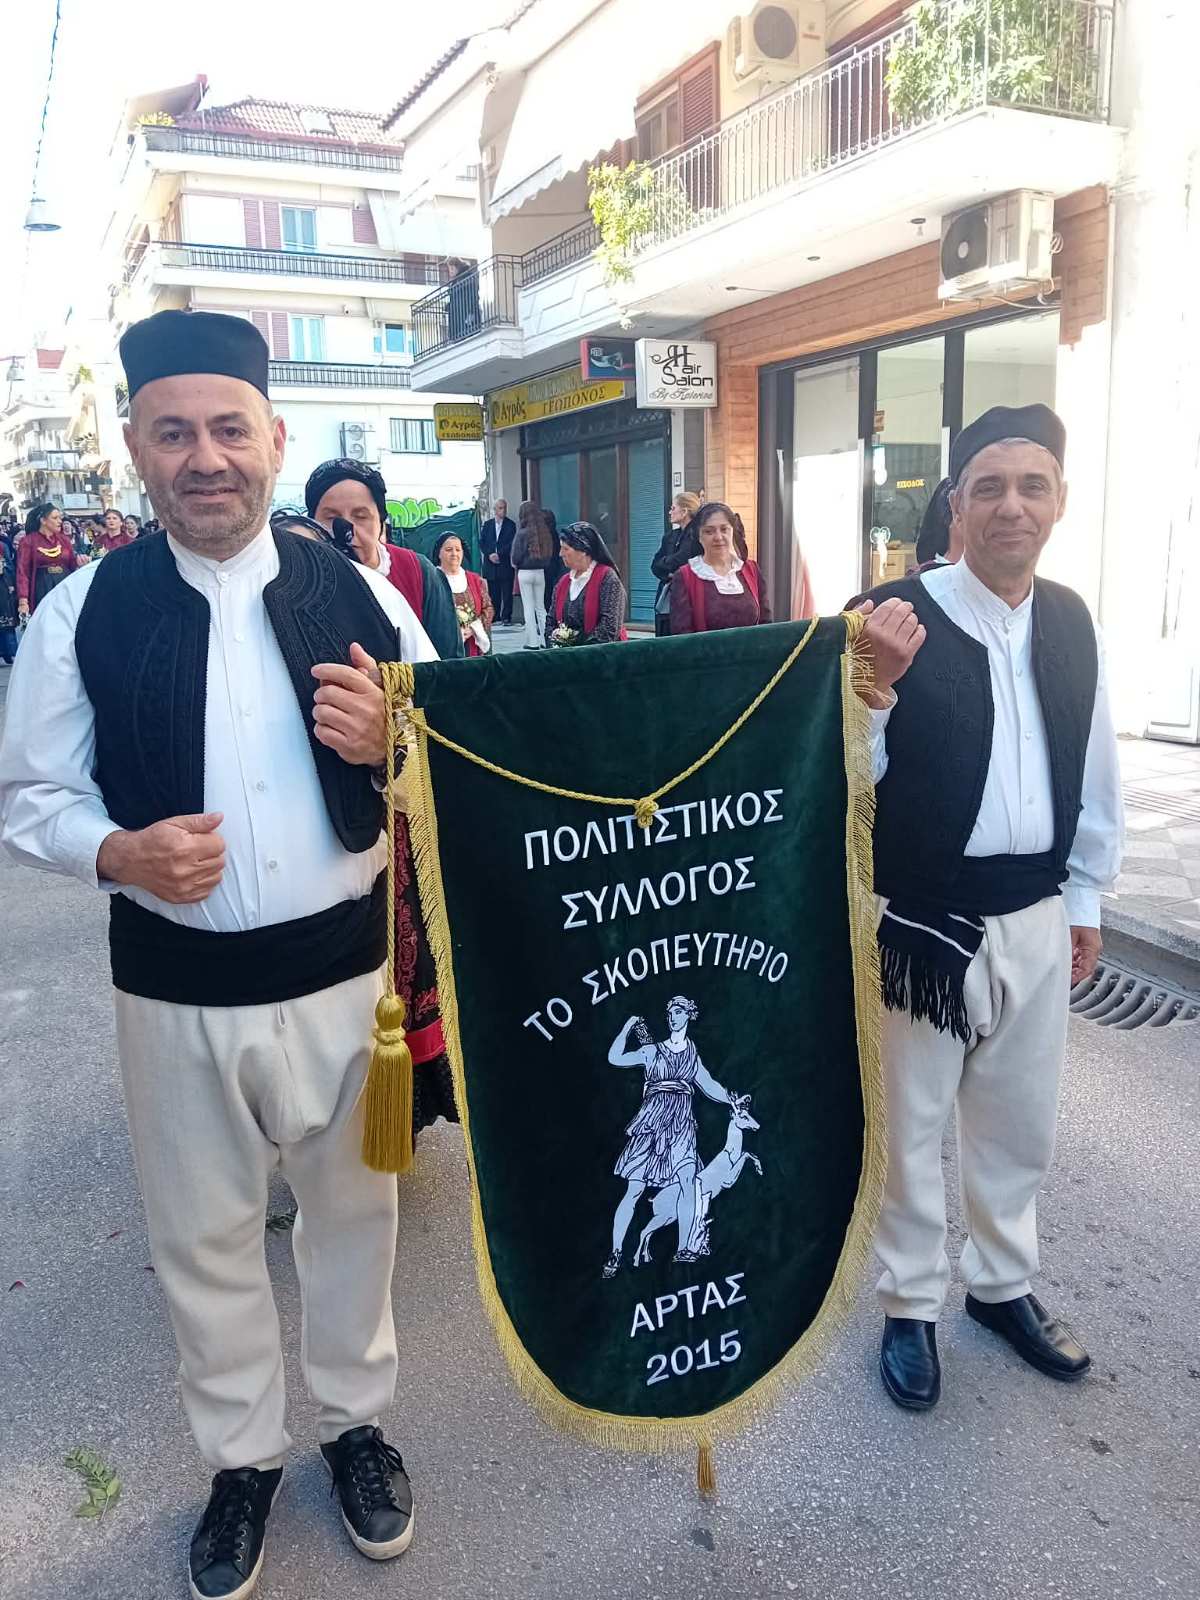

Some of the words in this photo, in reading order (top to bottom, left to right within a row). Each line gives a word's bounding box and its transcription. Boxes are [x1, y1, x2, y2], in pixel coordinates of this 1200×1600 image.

[650, 345, 702, 374] Hair
[662, 360, 714, 387] Salon
[543, 385, 606, 415] ΓΕΩΠΟΝΟΣ
[524, 788, 784, 870] ΠΟΛΙΤΙΣΤΙΚΟΣ
[561, 856, 756, 930] ΣΥΛΛΟΓΟΣ
[522, 997, 573, 1042] ΤΟ
[582, 931, 789, 1006] ΣΚΟΠΕΥΤΗΡΙΟ
[630, 1272, 747, 1338] ΑΡΤΑΣ
[646, 1329, 742, 1386] 2015
